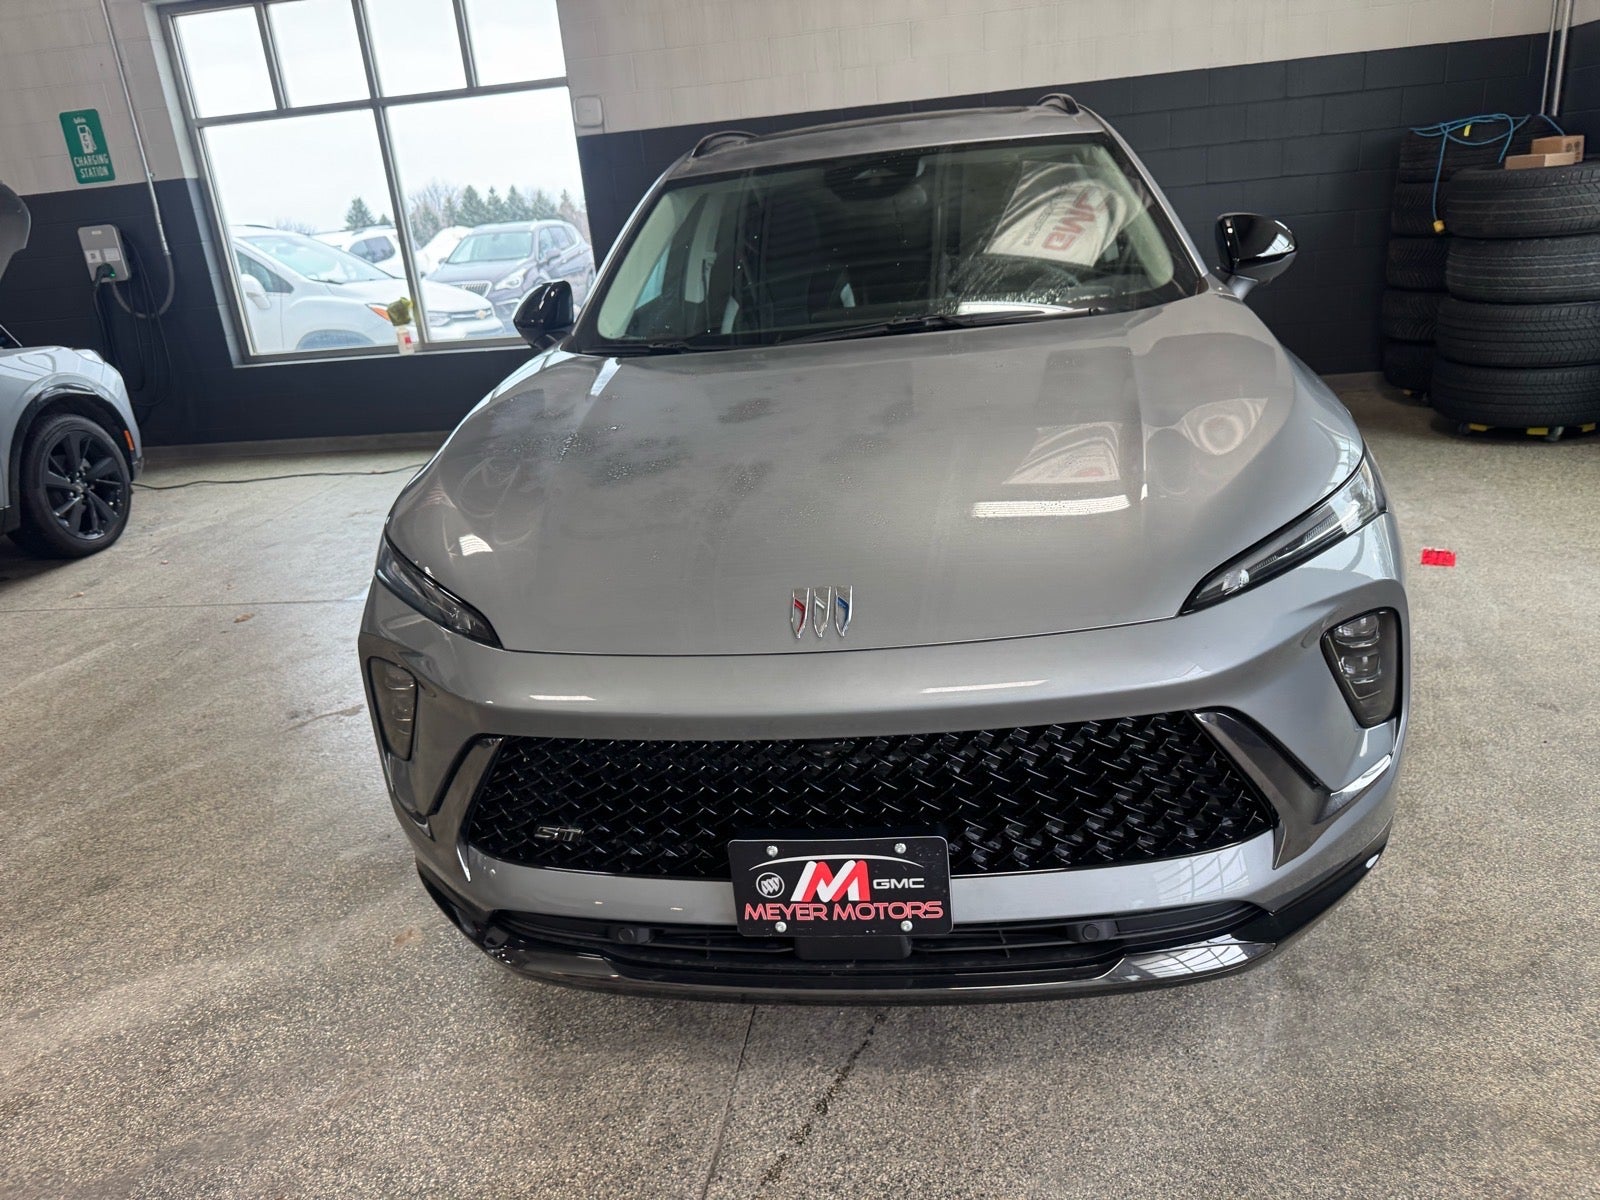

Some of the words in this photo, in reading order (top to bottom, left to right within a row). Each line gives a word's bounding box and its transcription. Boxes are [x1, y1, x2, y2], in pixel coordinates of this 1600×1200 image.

[73, 154, 109, 167] CHARGING
[80, 166, 109, 178] STATION
[873, 878, 925, 890] GMC
[744, 903, 828, 921] MEYER
[833, 901, 944, 921] MOTORS
